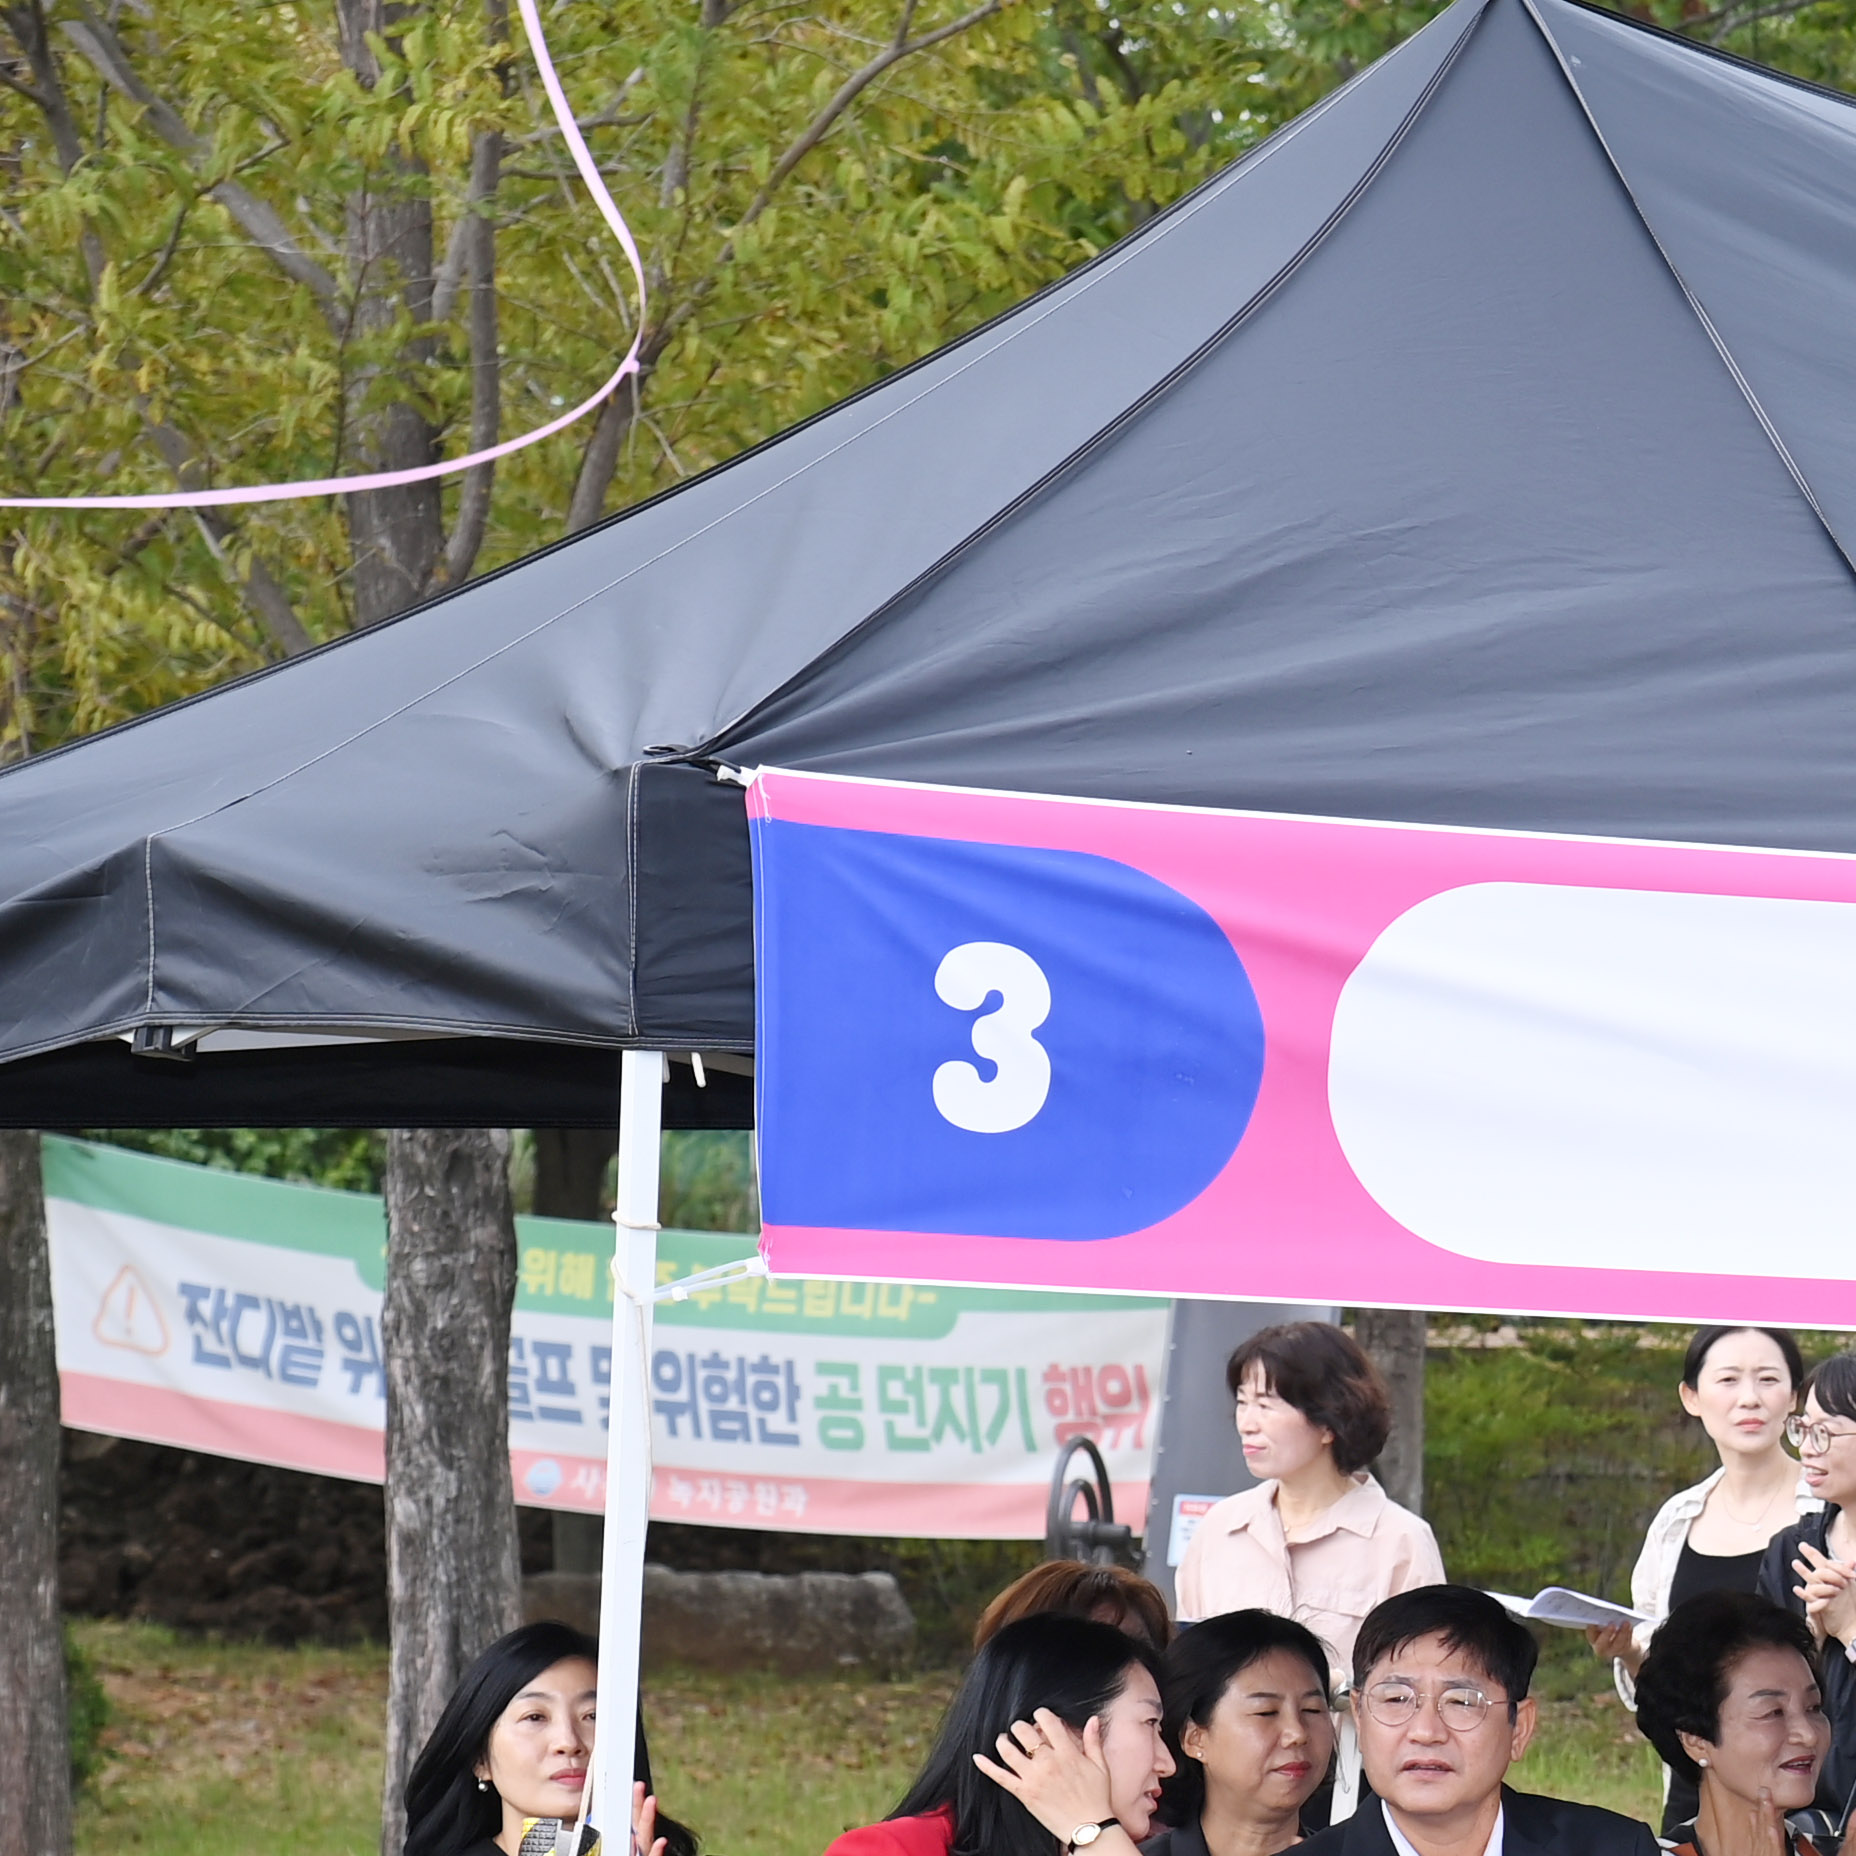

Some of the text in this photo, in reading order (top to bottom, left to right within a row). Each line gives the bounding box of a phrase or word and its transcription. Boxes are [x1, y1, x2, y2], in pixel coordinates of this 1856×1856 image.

[932, 941, 1052, 1134] 3
[522, 1247, 597, 1302] 위해
[177, 1281, 325, 1391] 잔디밭
[650, 1350, 802, 1447] 위험한
[814, 1361, 866, 1452] 공
[876, 1364, 1040, 1454] 던지기
[1042, 1362, 1151, 1452] 행위
[667, 1475, 810, 1518] 녹지공원과
